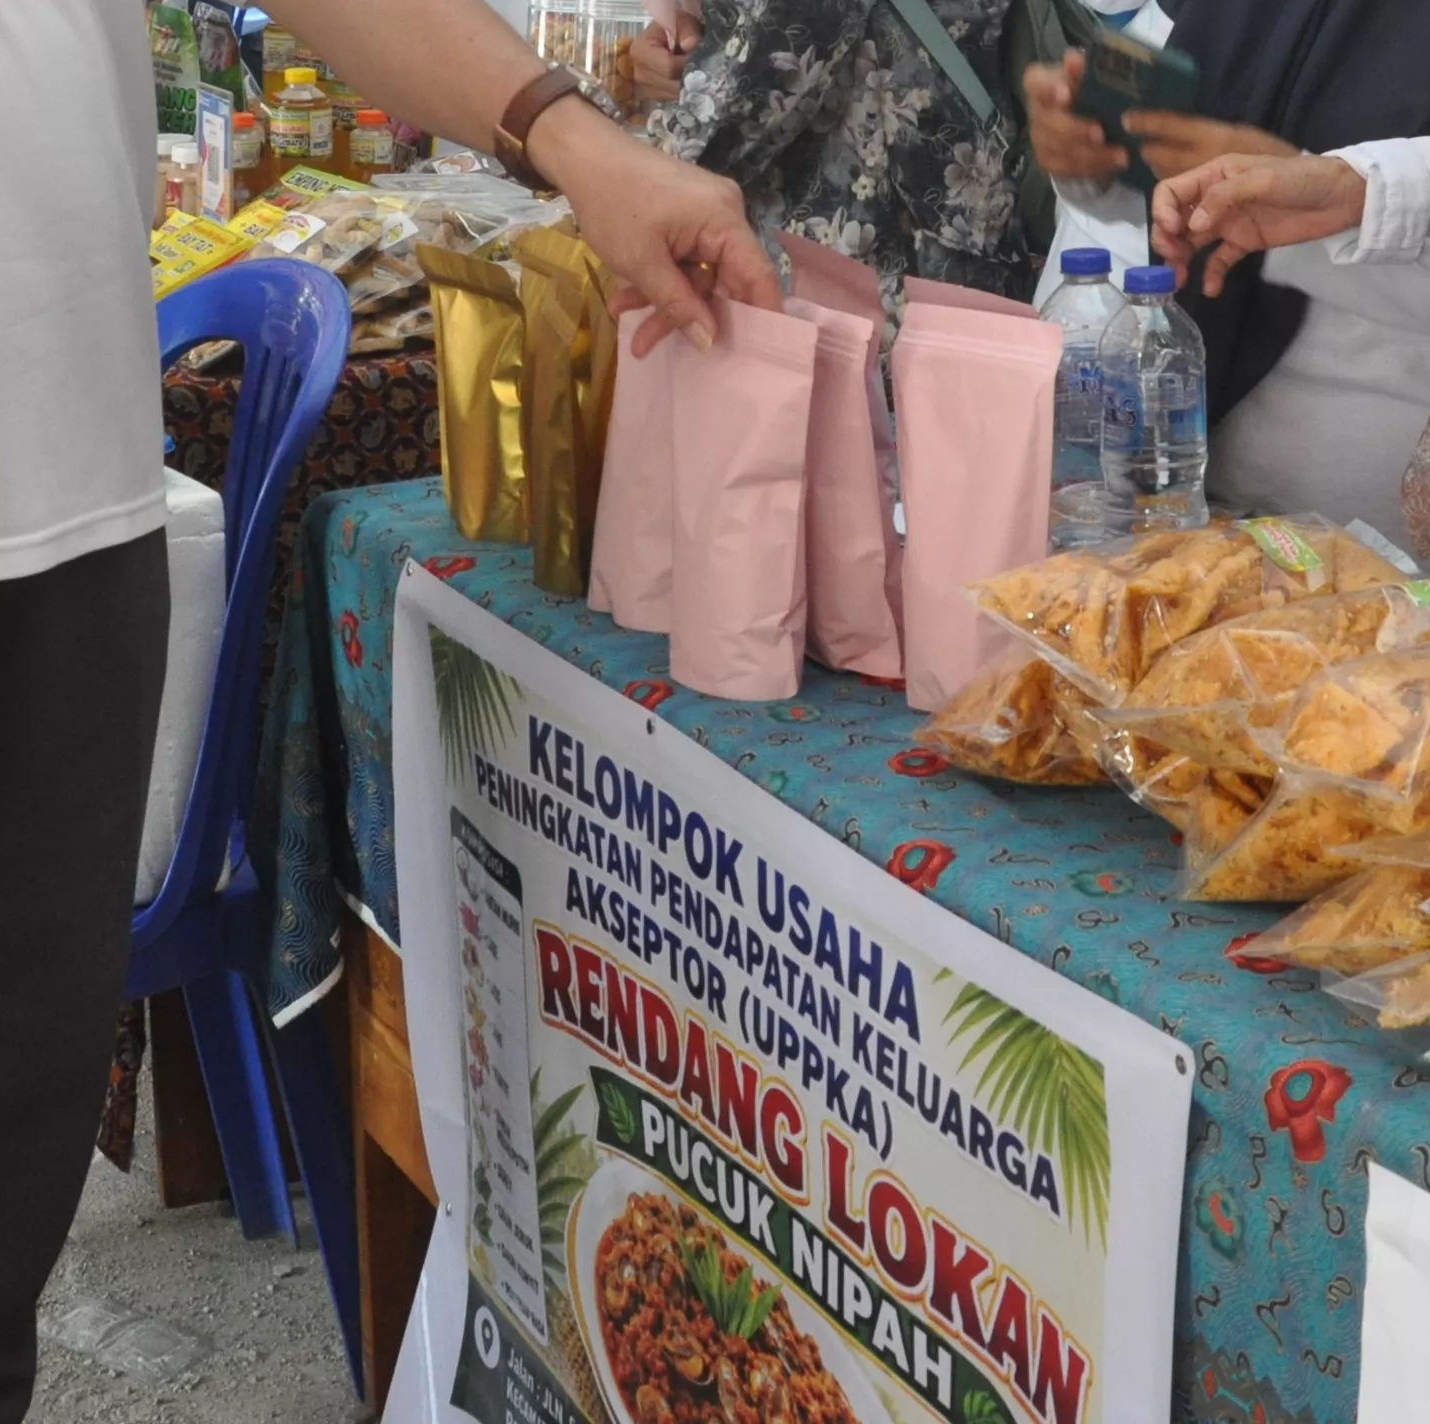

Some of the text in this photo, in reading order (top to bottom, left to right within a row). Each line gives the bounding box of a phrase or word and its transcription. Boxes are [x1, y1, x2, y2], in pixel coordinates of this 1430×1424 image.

[475, 754, 1061, 1216] PENINGKATAN PENDAPATAN KELUARGA
[528, 716, 921, 1043] KELOMPOK USAHA
[565, 875, 895, 1161] AKSEPTOR (UPPKA)
[537, 926, 1087, 1424] RENDANG LOKAN
[643, 1105, 955, 1412] PUCUK NIPAH
[505, 1376, 549, 1424] KECAM
[507, 1347, 535, 1394] Jalan
[542, 1388, 565, 1424] JLN
